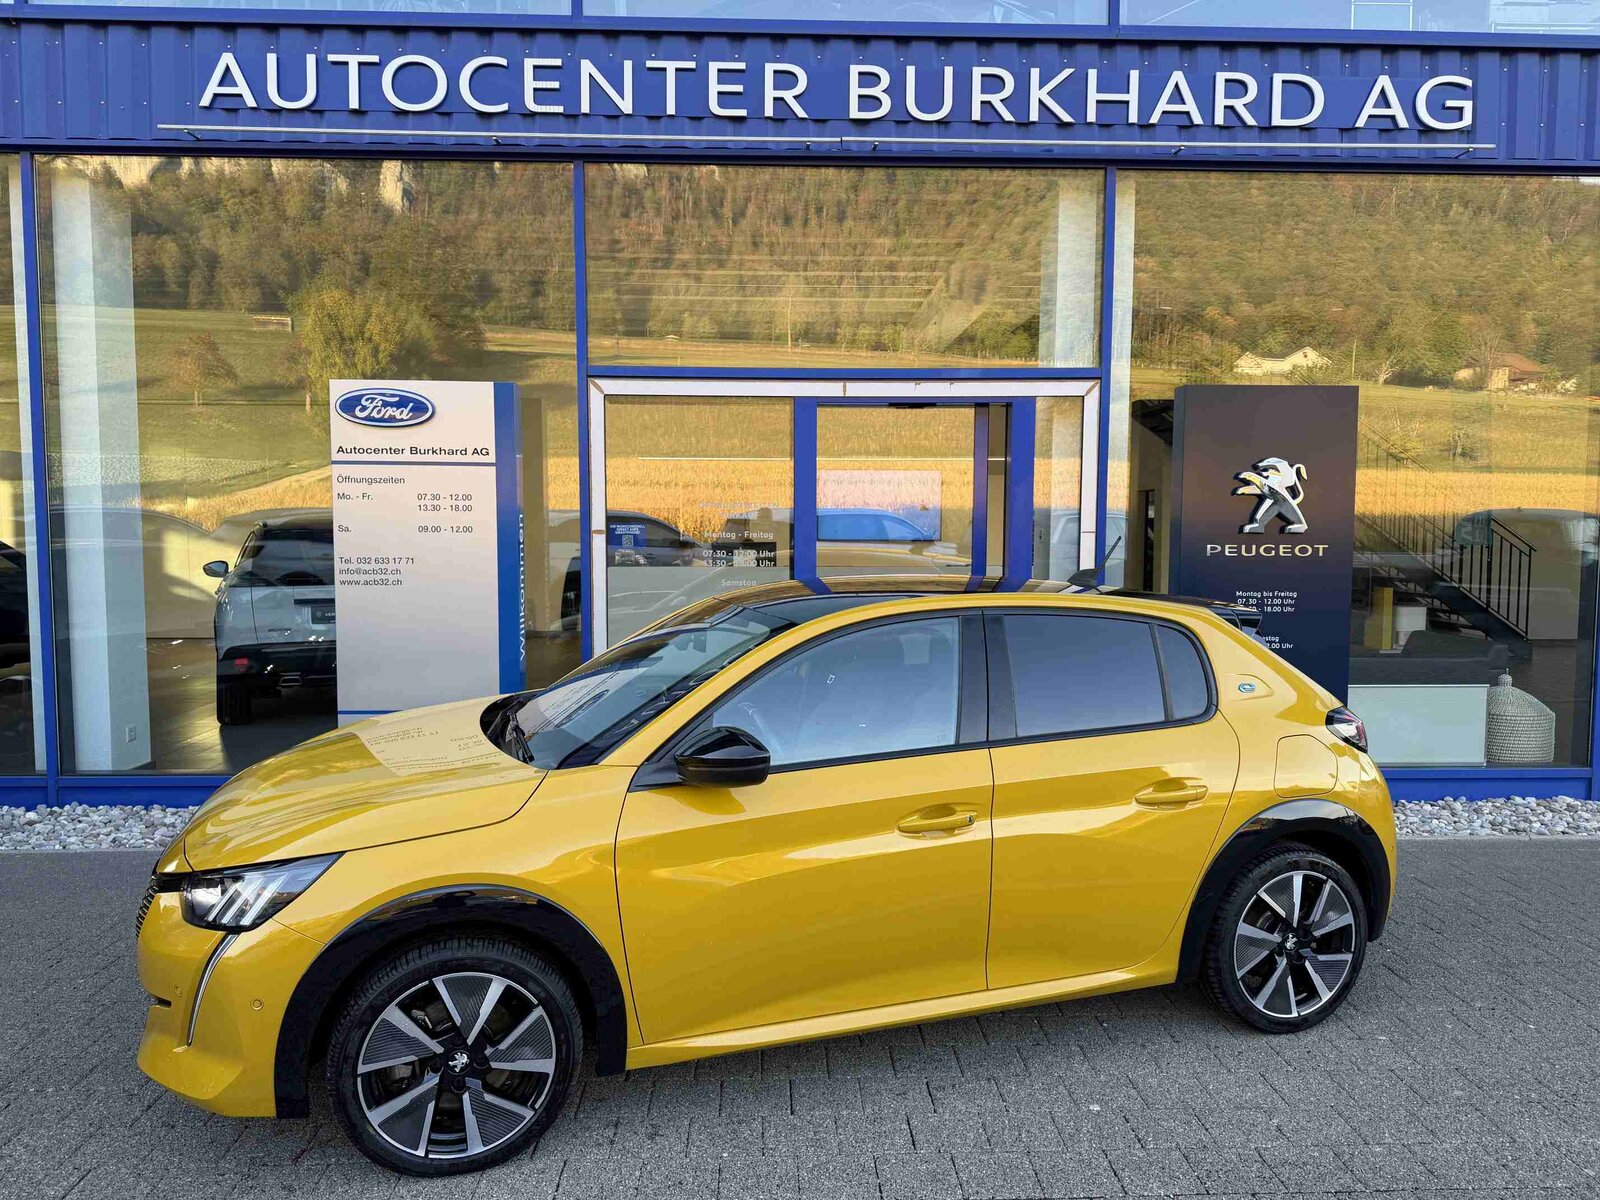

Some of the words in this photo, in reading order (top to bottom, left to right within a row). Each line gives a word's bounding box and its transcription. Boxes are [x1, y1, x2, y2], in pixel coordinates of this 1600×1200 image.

[199, 51, 809, 119] AUTOCENTER
[847, 63, 1325, 128] BURKHARD
[1354, 74, 1474, 131] AG
[354, 394, 413, 420] Ford
[336, 445, 405, 455] Autocenter
[409, 446, 468, 456] Burkhard
[471, 447, 490, 456] AG
[336, 474, 406, 486] Öffnungszeiten
[337, 492, 354, 501] Mo.
[361, 492, 374, 501] Fr.
[416, 493, 441, 502] 07.30
[449, 493, 473, 502] 12.00
[417, 503, 441, 512] 13.30
[449, 503, 473, 512] 18.00
[337, 524, 352, 533] Sa.
[417, 525, 442, 534] 09.00
[450, 525, 473, 534] 12.00
[704, 530, 736, 540] Montag
[744, 530, 774, 540] Freitag
[702, 549, 727, 558] 07:30
[759, 549, 775, 558] Uhr
[1206, 544, 1329, 557] PEUGEOT
[338, 556, 355, 565] Tel.
[356, 556, 372, 565] 032
[374, 556, 390, 565] 633
[393, 557, 403, 565] 17
[405, 557, 415, 565] 71
[759, 559, 775, 567] Uhr
[338, 567, 402, 576] info@acb32.ch
[339, 578, 403, 587] www.acb32.ch
[518, 513, 526, 661] Willkommen
[1235, 590, 1262, 598] Montag
[1274, 590, 1298, 598] Freitag
